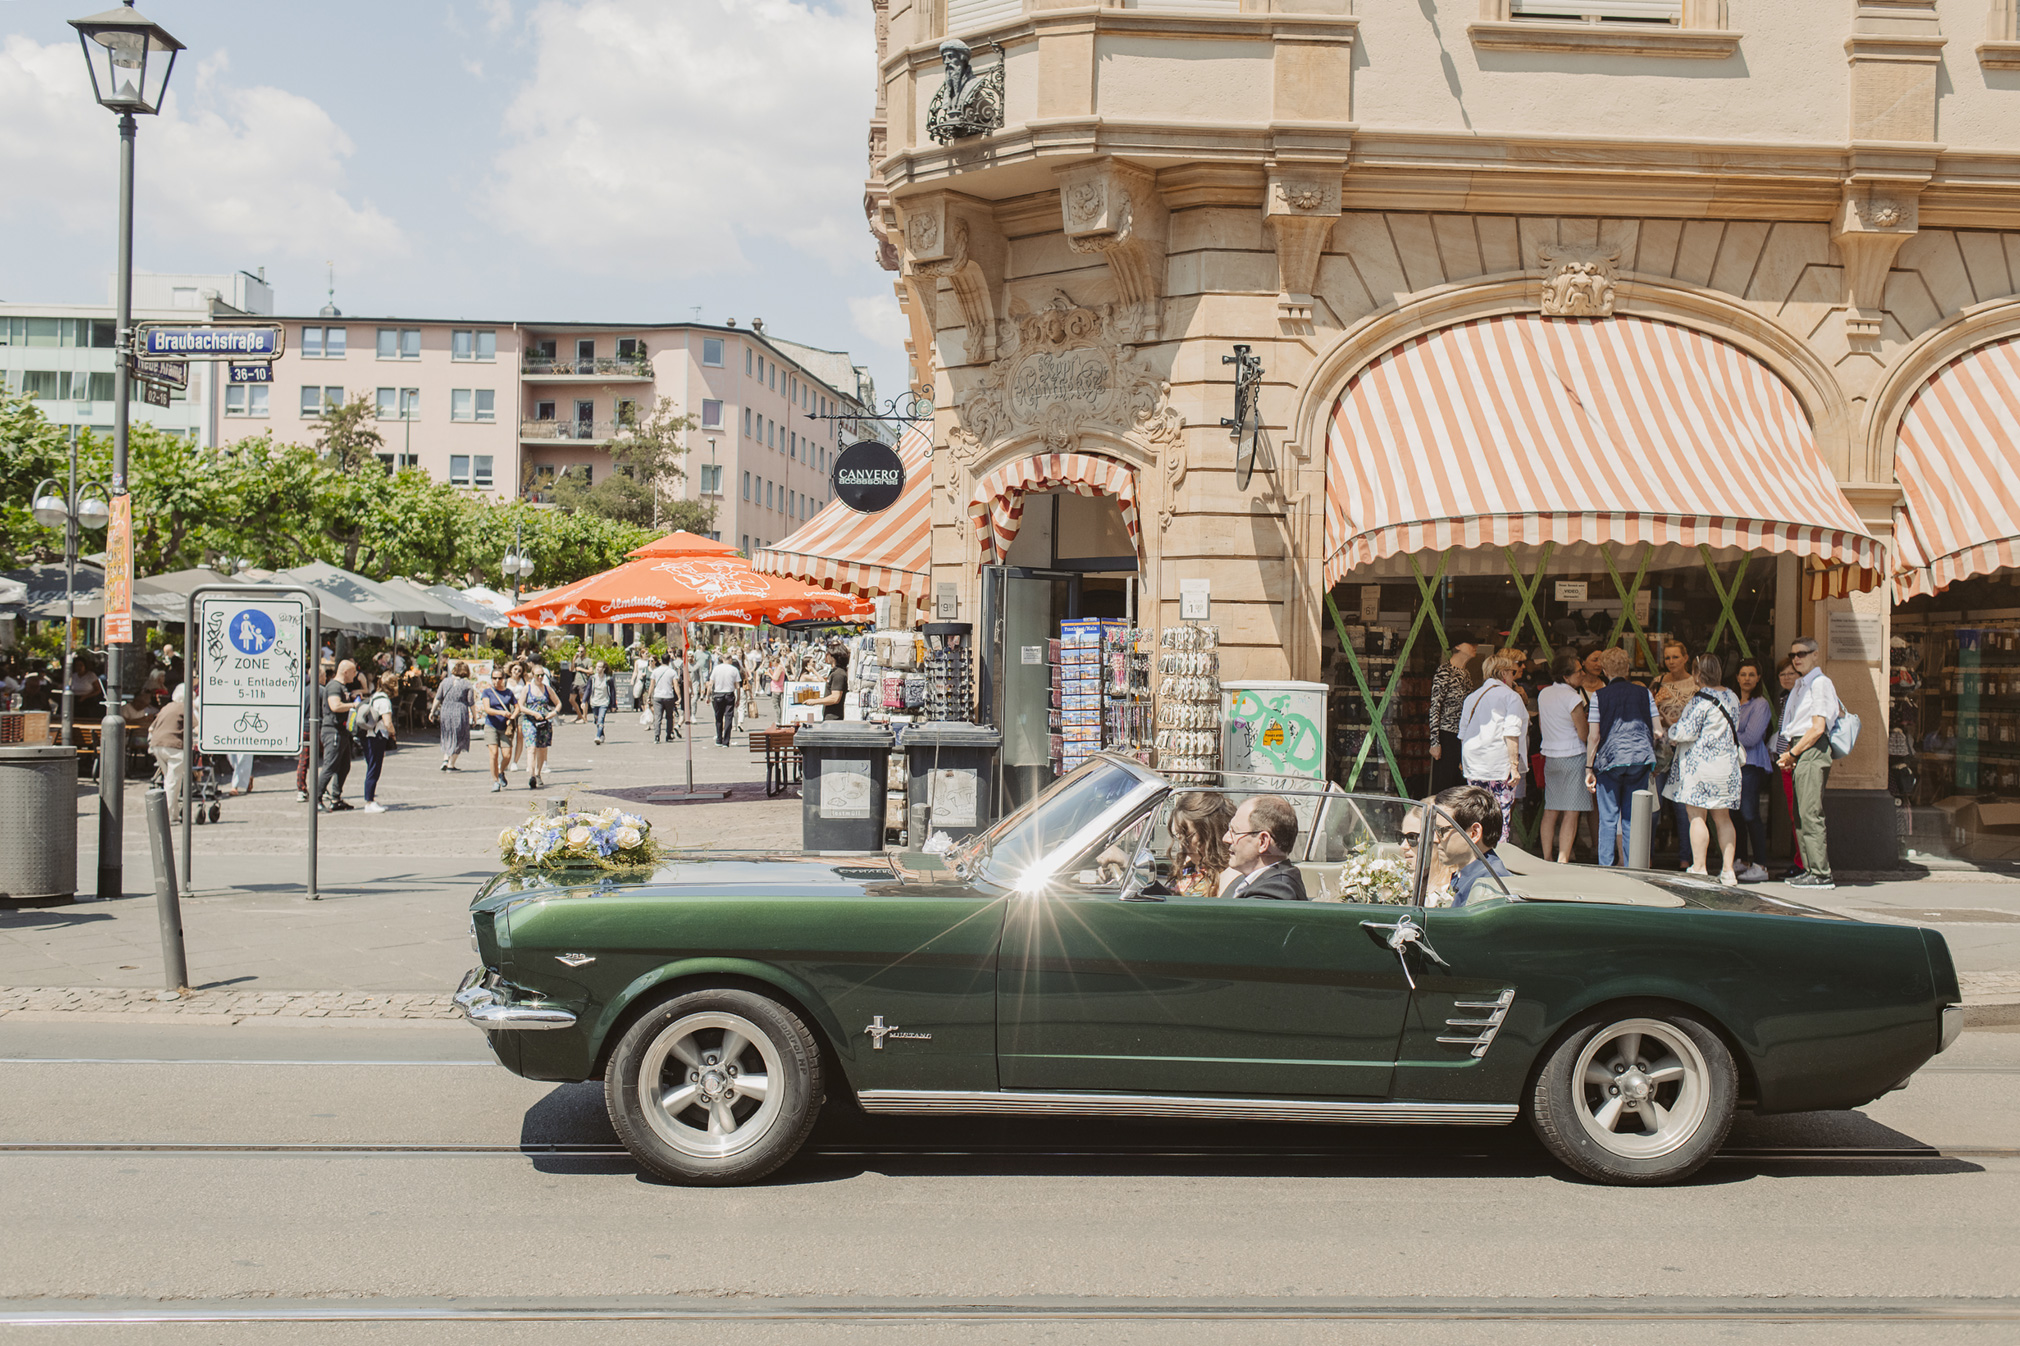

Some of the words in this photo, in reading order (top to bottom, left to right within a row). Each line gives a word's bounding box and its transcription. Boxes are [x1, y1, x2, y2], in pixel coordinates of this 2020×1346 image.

[155, 332, 264, 352] Braubachstraße
[147, 390, 167, 405] 02-16
[838, 468, 899, 480] CANVERO
[600, 595, 669, 613] Almdudler
[235, 658, 270, 670] ZONE
[209, 677, 229, 686] Be-
[233, 678, 243, 687] u.
[247, 677, 296, 688] Entladen
[238, 689, 266, 699] 5-11h
[889, 1032, 932, 1040] MUSTANG
[798, 1058, 807, 1075] HP
